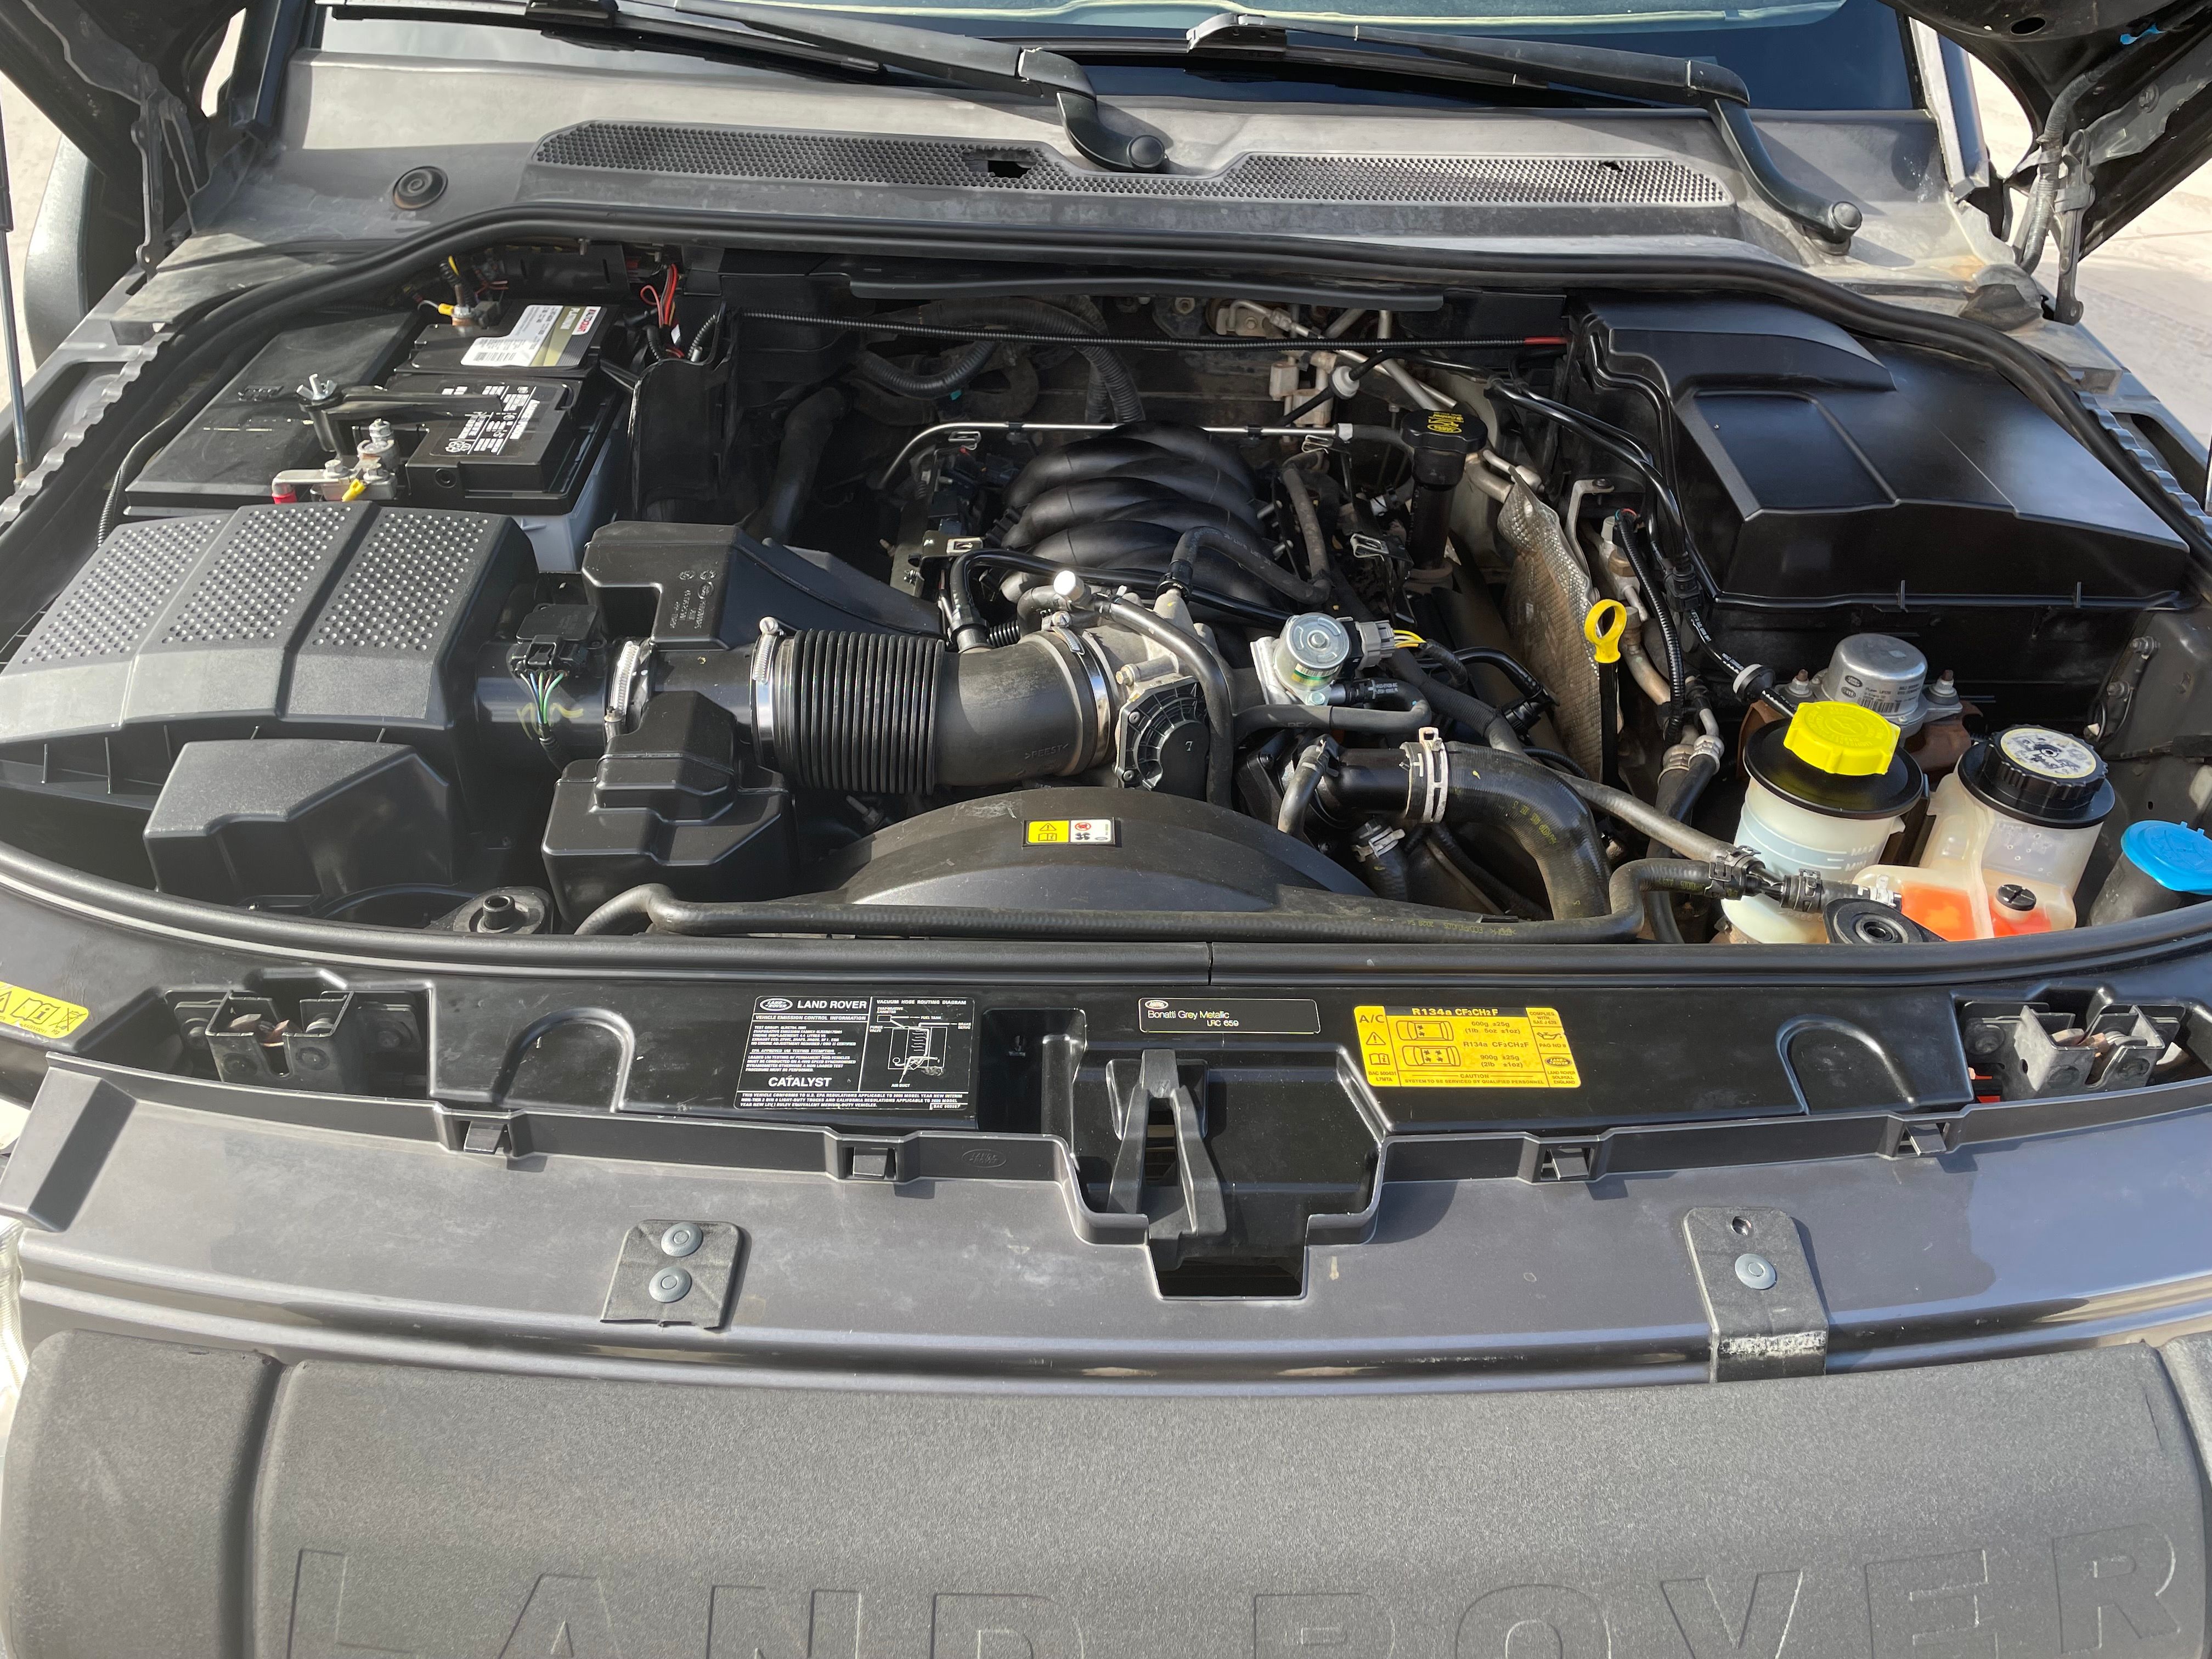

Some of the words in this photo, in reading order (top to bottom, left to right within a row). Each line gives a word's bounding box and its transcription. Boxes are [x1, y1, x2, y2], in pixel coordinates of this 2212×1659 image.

[1185, 741, 1193, 751] 7
[1850, 844, 1875, 856] MAX
[1844, 860, 1867, 871] MIN
[830, 1001, 867, 1009] ROVER
[1178, 1011, 1198, 1020] Grey
[1359, 1014, 1385, 1023] A/C
[768, 1077, 832, 1087] CATALYST
